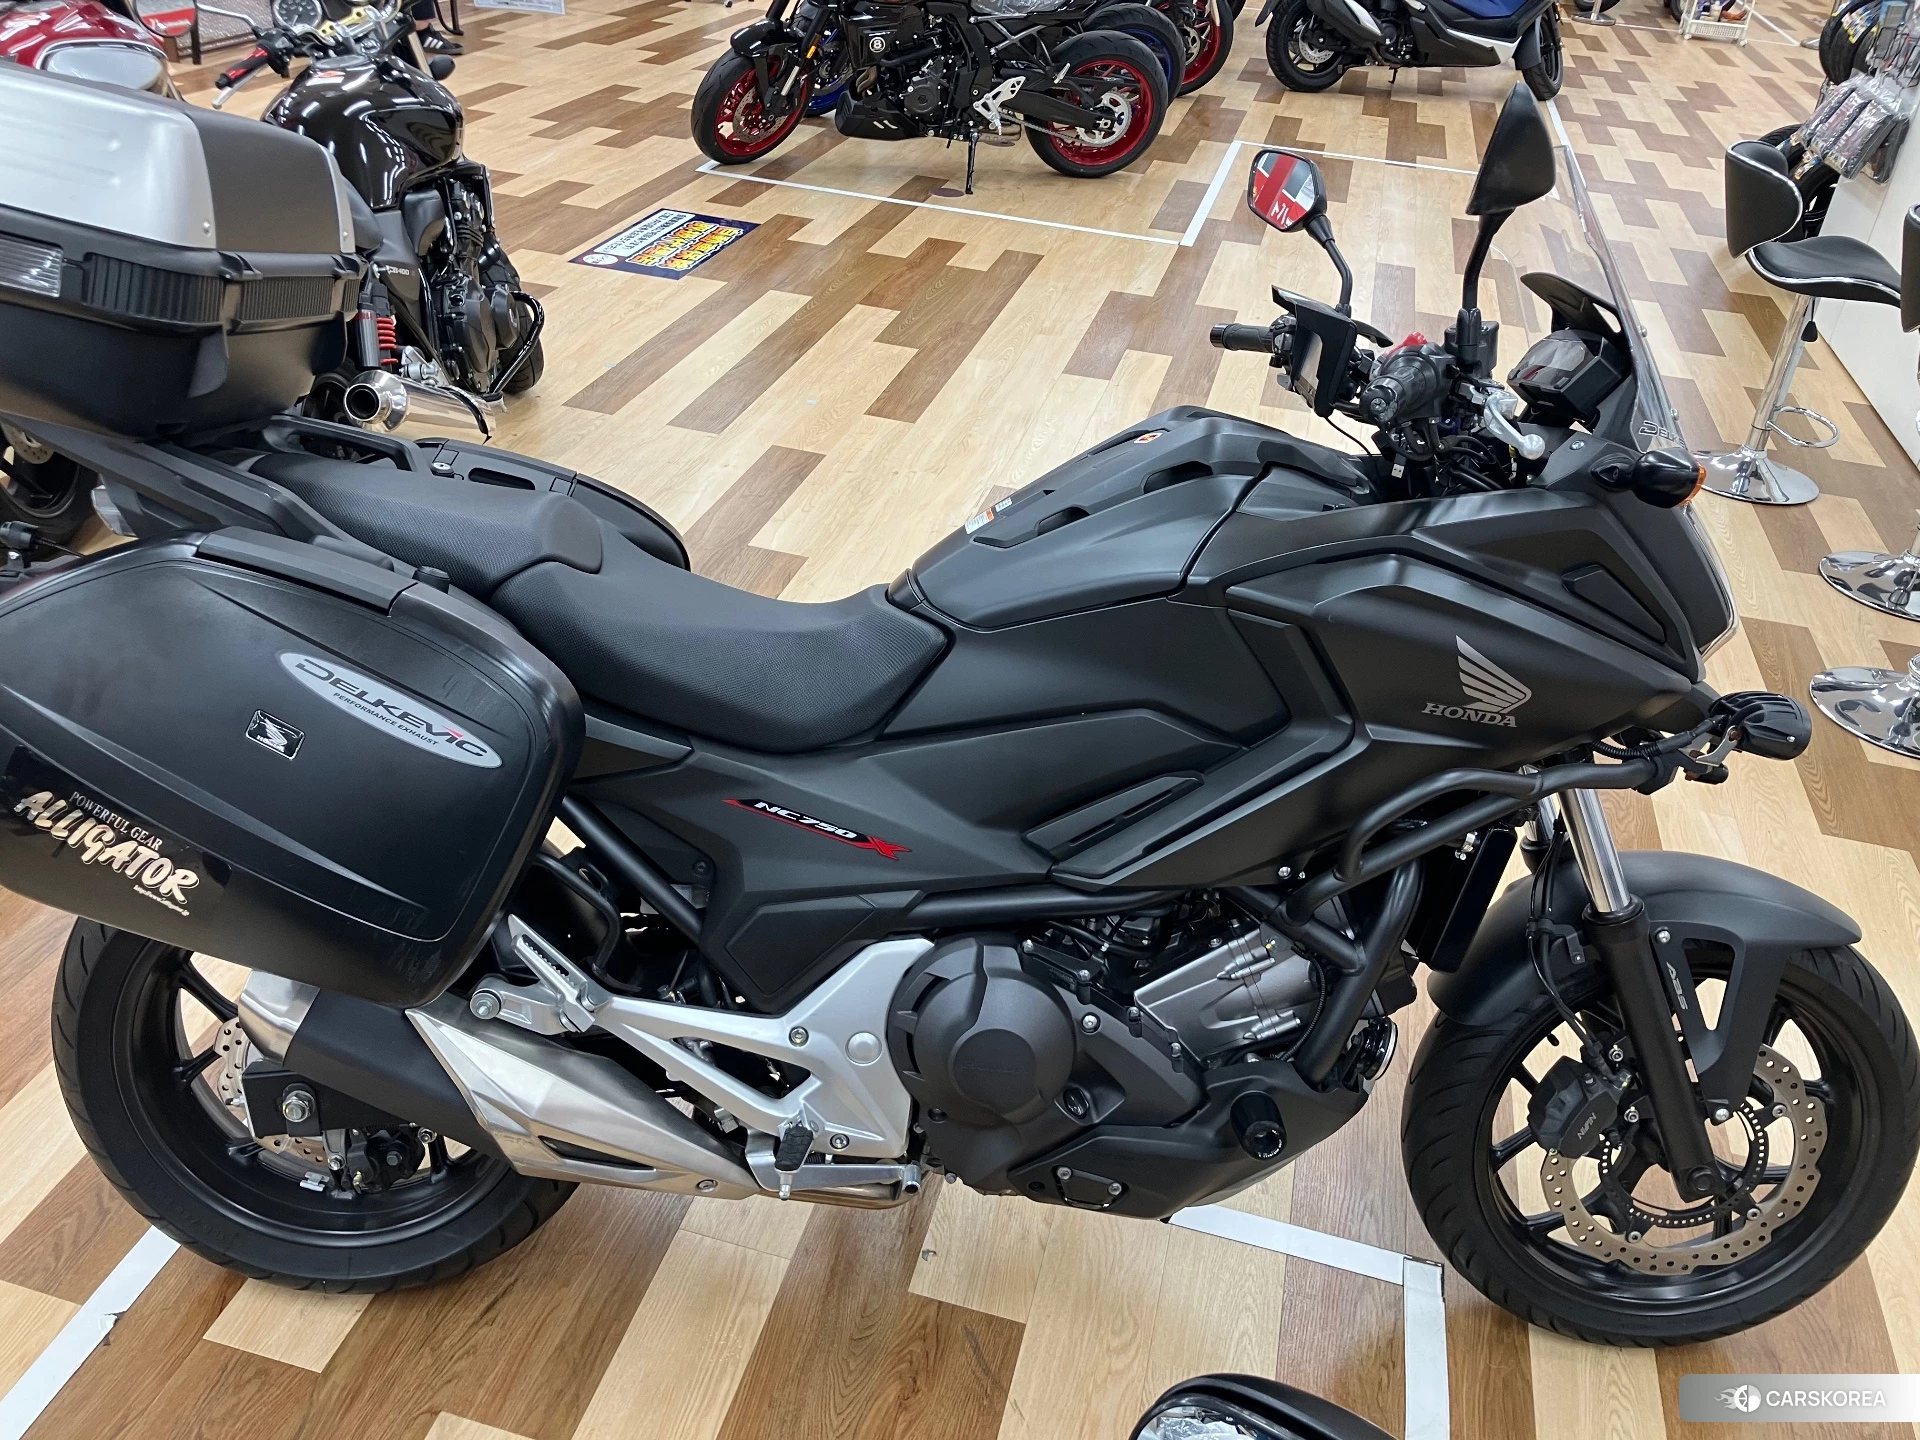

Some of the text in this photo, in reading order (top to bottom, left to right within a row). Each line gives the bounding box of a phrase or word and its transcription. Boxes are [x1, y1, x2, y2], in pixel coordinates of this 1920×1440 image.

[295, 658, 488, 757] DELKEVIC
[333, 692, 439, 745] PERFORMANCE EXHAUST
[1421, 702, 1518, 728] HONDA
[13, 791, 200, 905] ALLIGATOR
[70, 791, 163, 851] POWERFUL GEAR
[1666, 961, 1689, 1010] ABS
